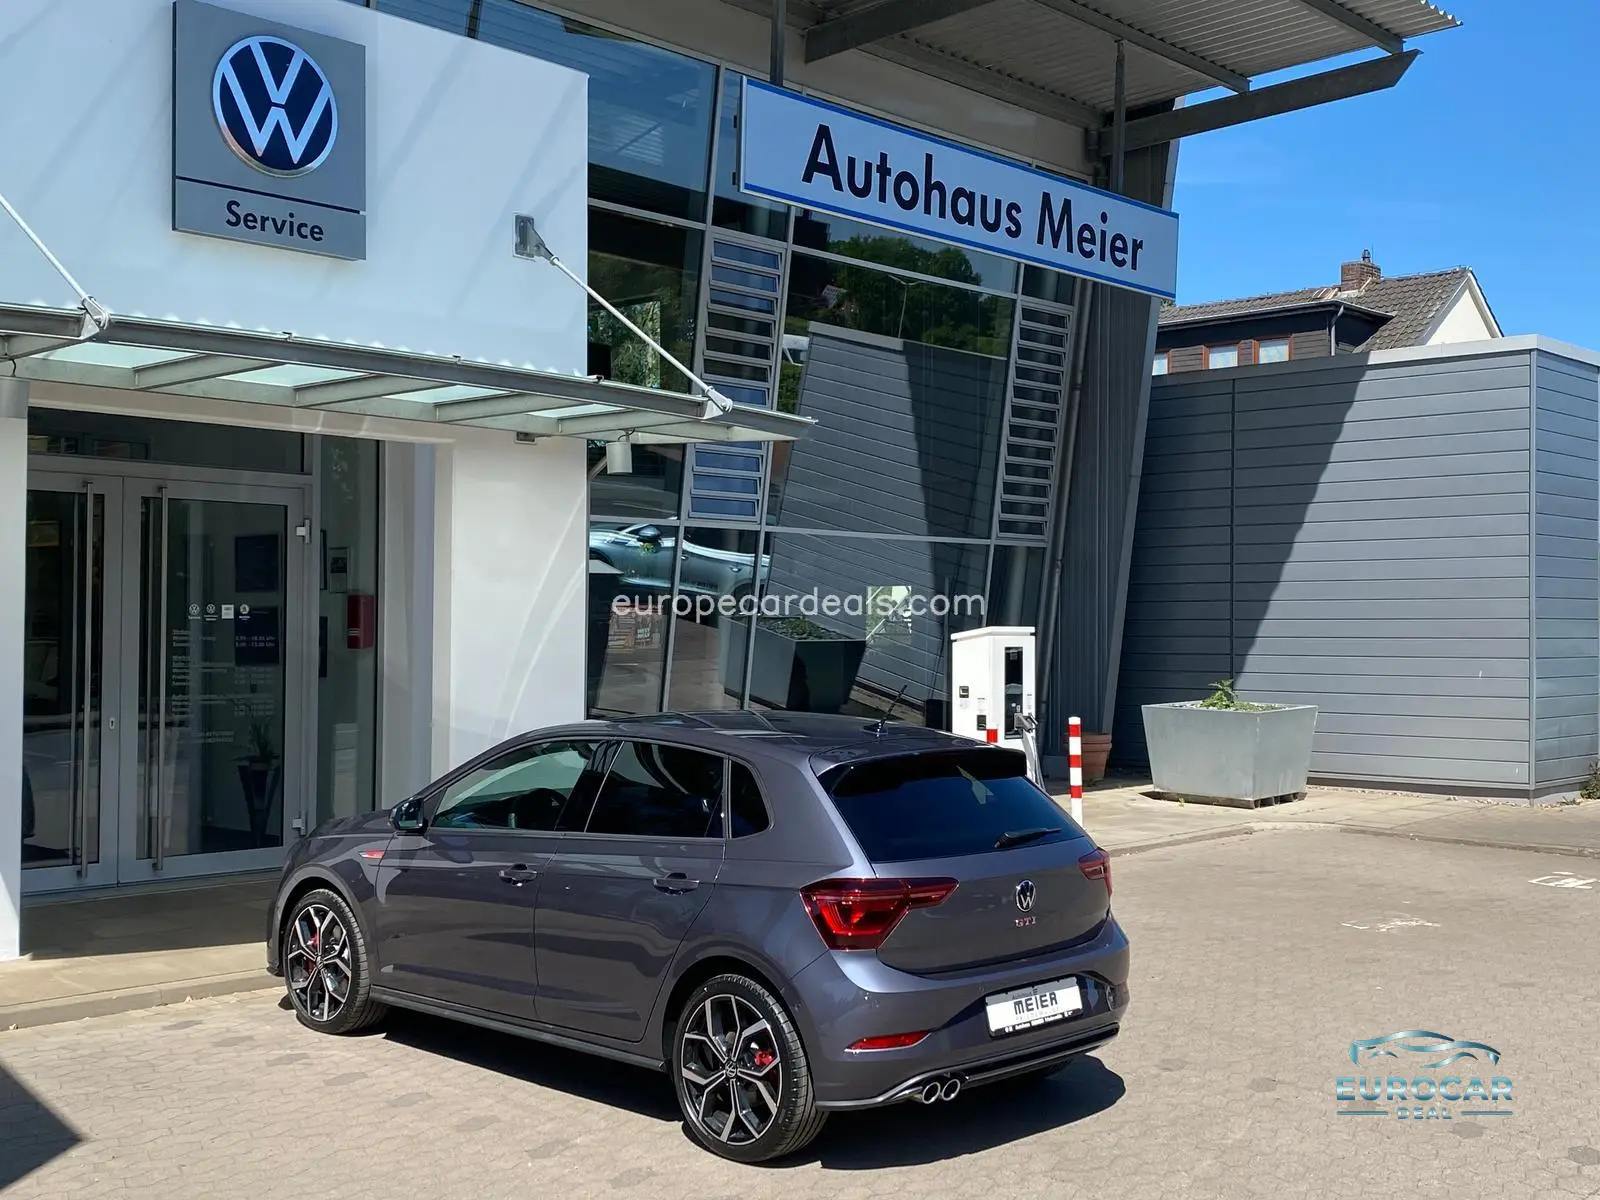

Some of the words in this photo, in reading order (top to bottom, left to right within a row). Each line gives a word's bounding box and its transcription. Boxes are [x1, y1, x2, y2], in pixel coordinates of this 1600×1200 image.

[218, 38, 333, 168] VW
[801, 122, 1022, 239] Autohaus
[1036, 191, 1144, 271] Meier
[225, 200, 324, 242] Service
[1015, 916, 1037, 928] GTI
[1014, 991, 1058, 1015] MEIER
